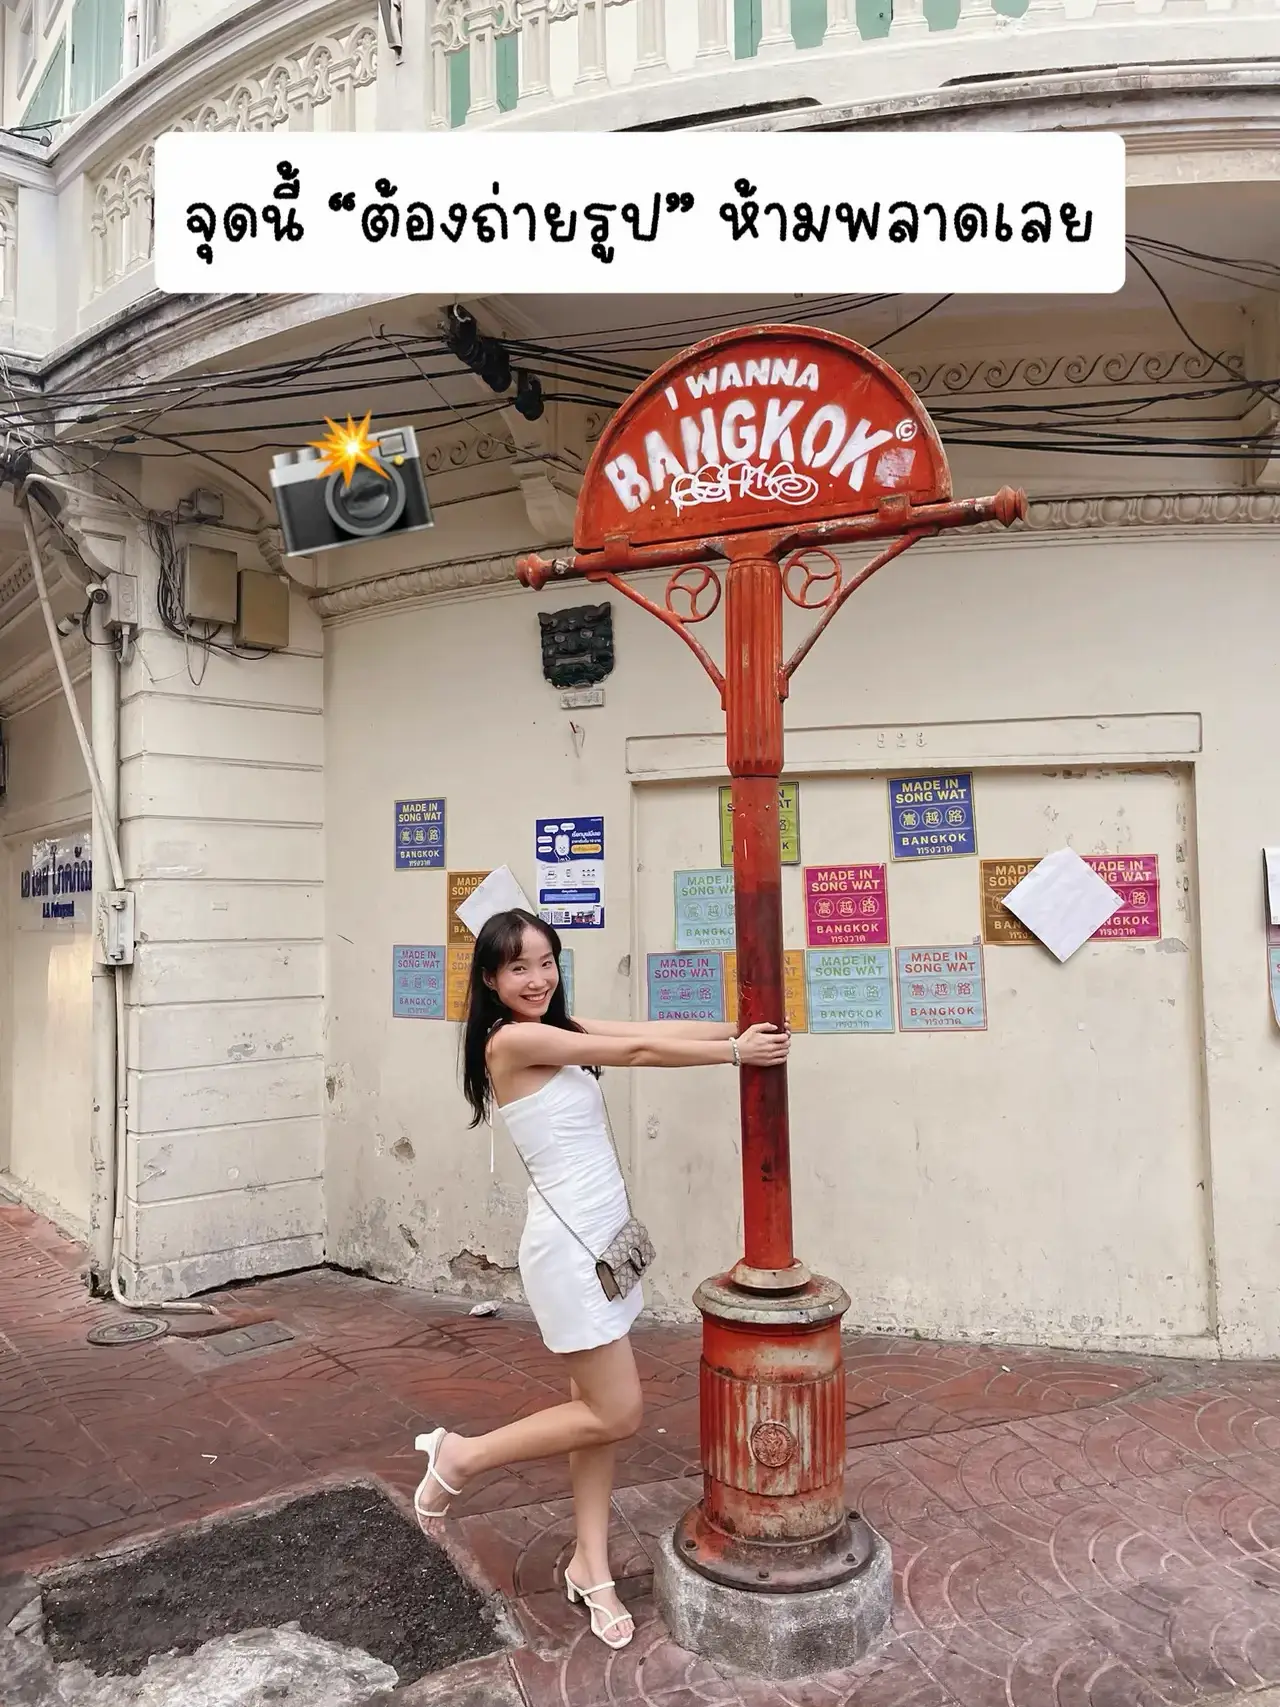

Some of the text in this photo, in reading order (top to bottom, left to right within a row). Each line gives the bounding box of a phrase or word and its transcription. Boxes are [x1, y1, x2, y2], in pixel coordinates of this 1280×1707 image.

[664, 358, 820, 411] I WANNA
[604, 398, 893, 513] BANGKOK
[902, 779, 958, 792] MADE IN
[895, 789, 966, 804] SONG WAT
[402, 802, 438, 813] MADE IN
[398, 812, 442, 822] SONG WAT
[902, 833, 967, 846] BANGKOK
[400, 849, 440, 859] BANGKOK
[917, 845, 953, 855] ทรงวาด
[1129, 860, 1143, 871] IN
[818, 869, 872, 881] MADE IN
[1122, 871, 1152, 882] WAT
[687, 876, 722, 885] MADE
[681, 886, 715, 896] SONG
[811, 880, 881, 892] SONG WAT
[686, 928, 734, 937] BANGKO
[816, 923, 879, 934] BANGKOK
[830, 935, 866, 943] ทรงวาด
[402, 951, 436, 959] MADE IN
[911, 952, 968, 962] MADE IN
[398, 960, 440, 968] SONG WAT
[660, 958, 709, 968] MADE IN
[821, 955, 876, 966] MADE IN
[815, 966, 884, 977] SONG WAT
[904, 962, 976, 973] SONG WAT
[654, 968, 716, 979] SONG WAT
[399, 997, 438, 1006] BANGKOK
[658, 1010, 714, 1019] BANGKOK
[820, 1009, 882, 1018] BANGKOK
[910, 1007, 974, 1016] BANGKOK
